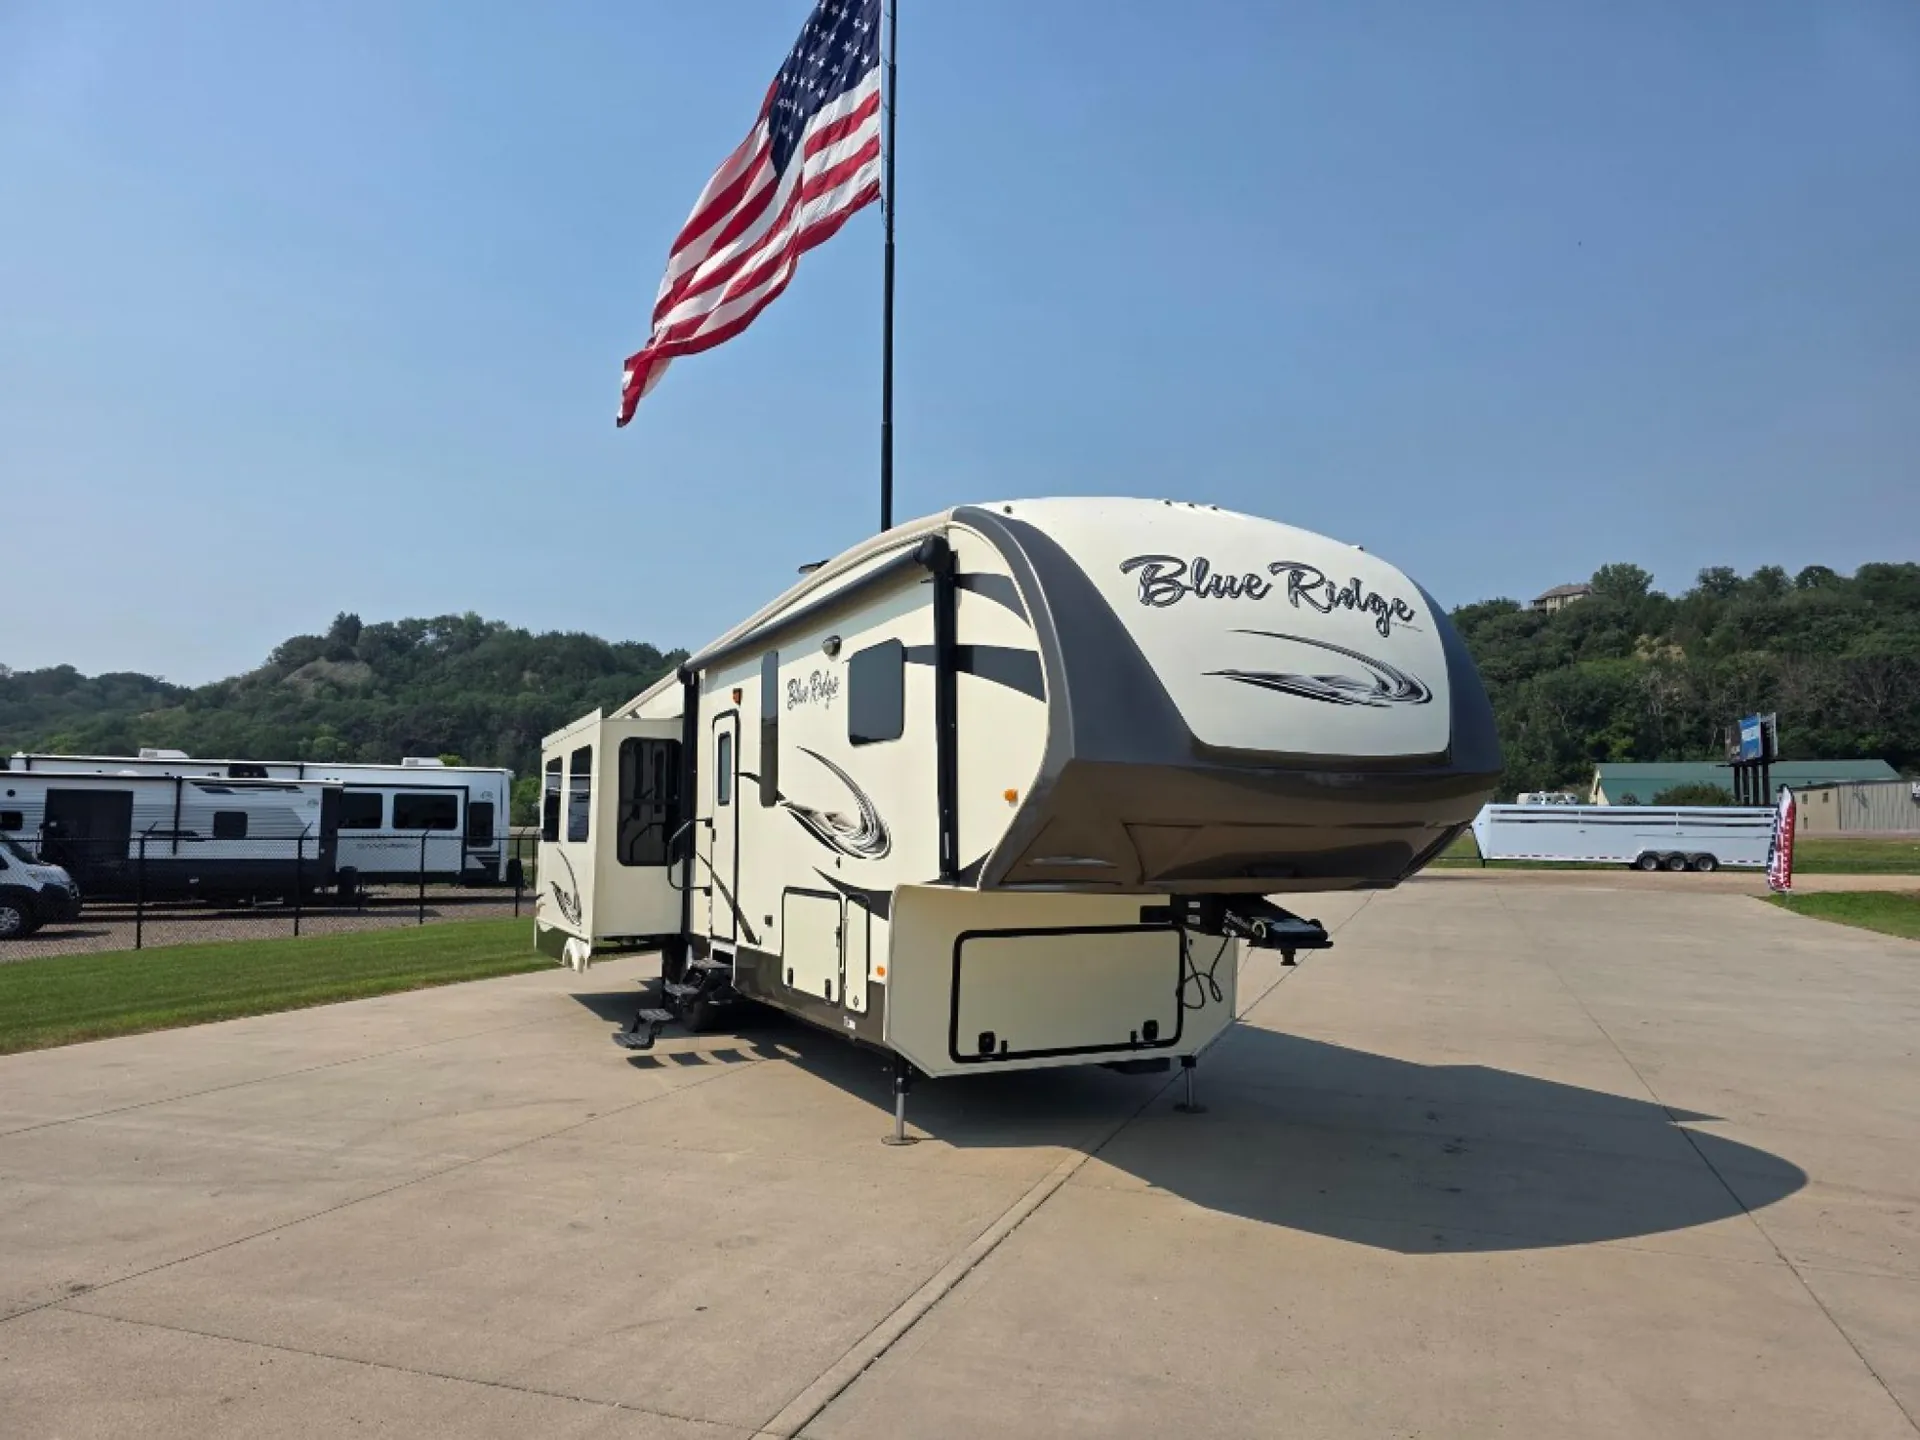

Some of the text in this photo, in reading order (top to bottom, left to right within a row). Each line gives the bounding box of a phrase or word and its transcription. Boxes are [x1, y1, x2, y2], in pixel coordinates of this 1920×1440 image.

[1119, 555, 1416, 638] Blue Ridge
[787, 670, 839, 711] Blue Ridge
